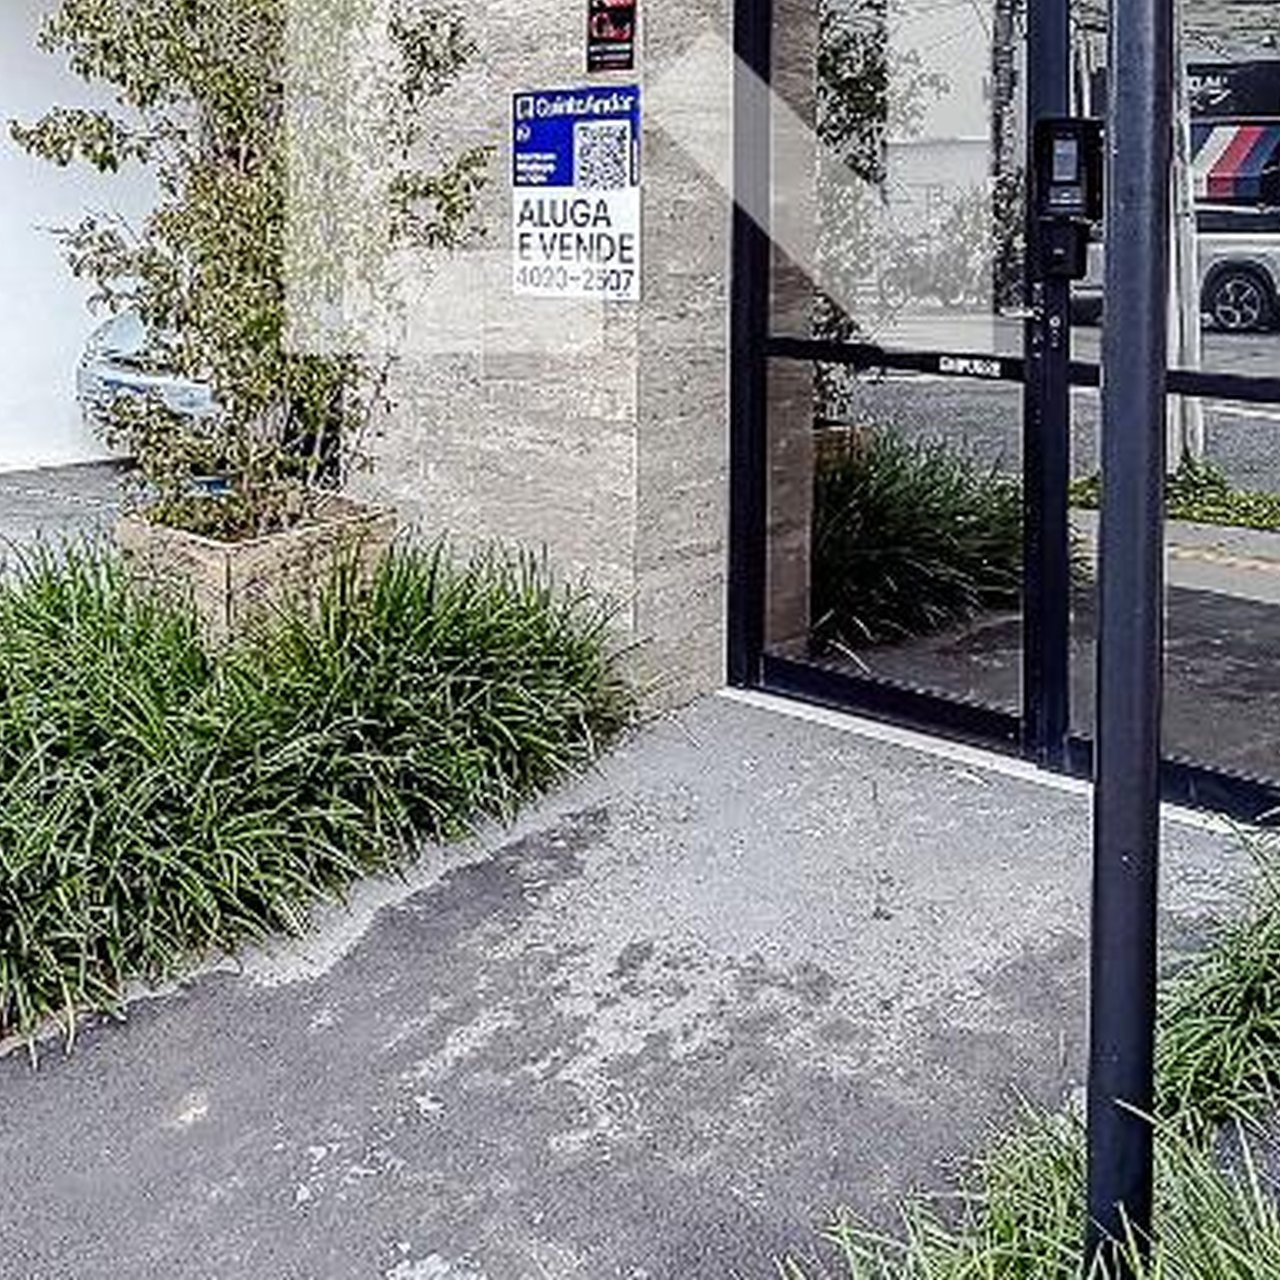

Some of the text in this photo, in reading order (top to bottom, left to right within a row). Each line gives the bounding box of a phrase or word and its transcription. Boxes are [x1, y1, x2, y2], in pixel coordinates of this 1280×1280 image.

[516, 198, 613, 228] ALUGA
[518, 233, 635, 264] E VENDE
